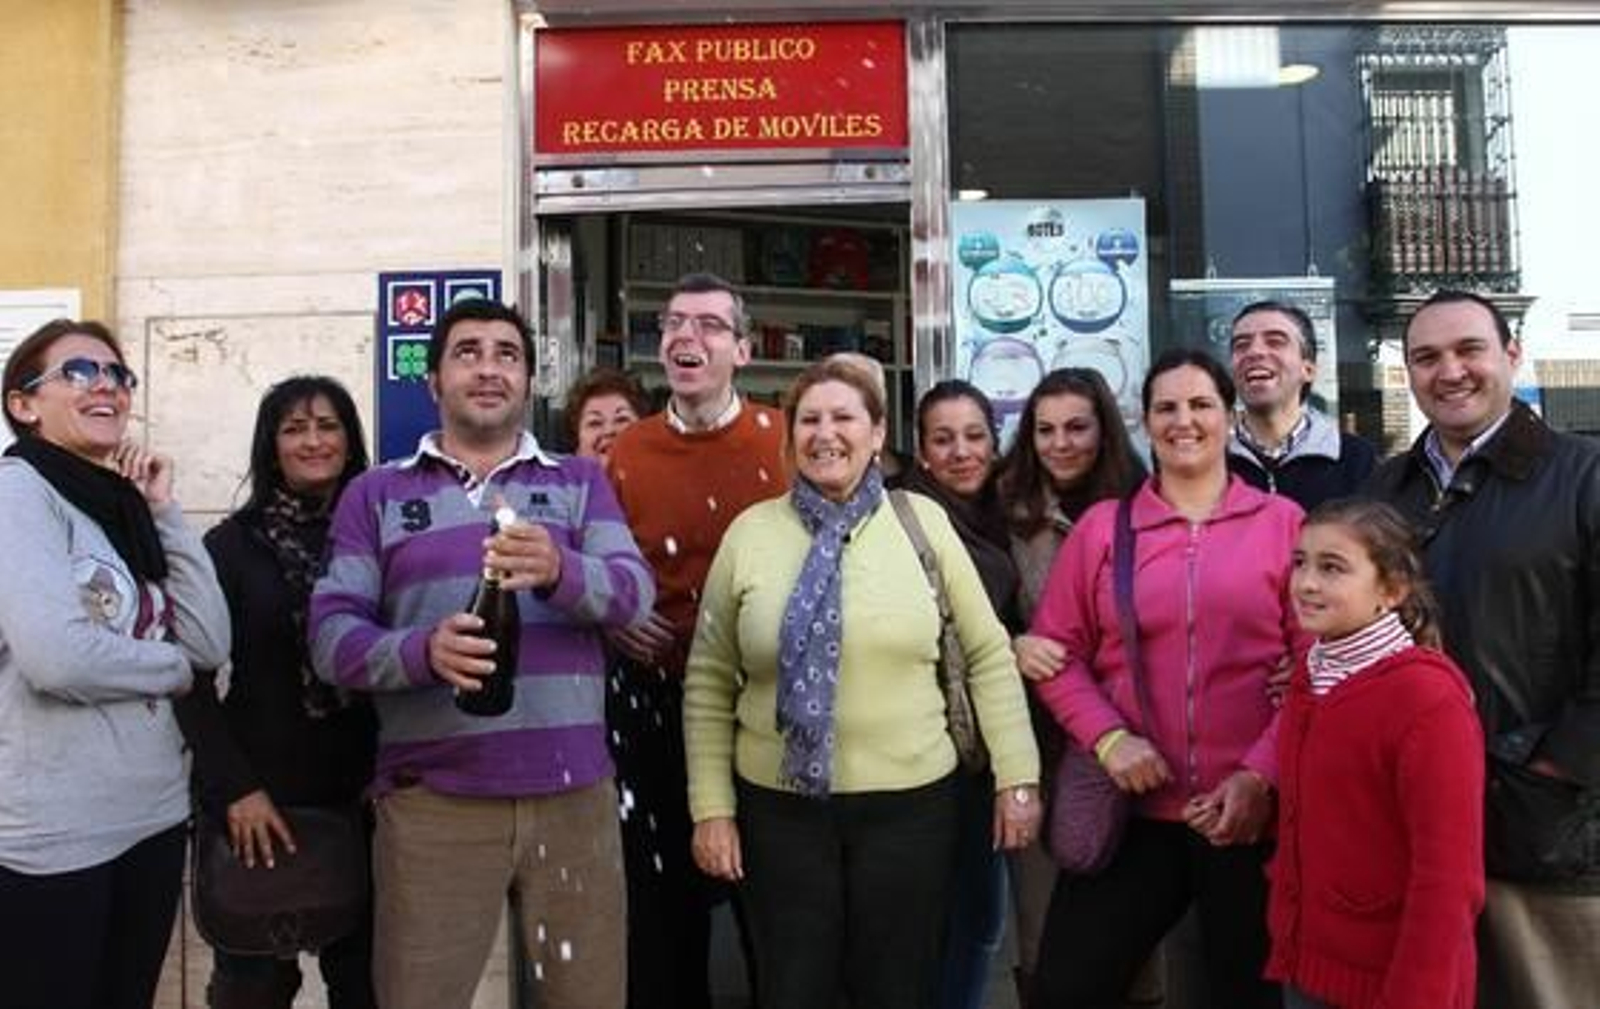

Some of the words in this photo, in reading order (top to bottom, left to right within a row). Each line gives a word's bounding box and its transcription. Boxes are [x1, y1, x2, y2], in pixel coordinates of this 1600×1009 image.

[627, 41, 686, 64] FAX
[696, 38, 815, 62] PUBLICO
[664, 77, 777, 103] PRENSA
[563, 118, 705, 145] RECARGA
[713, 116, 749, 140] DE
[758, 112, 883, 139] MOVILES
